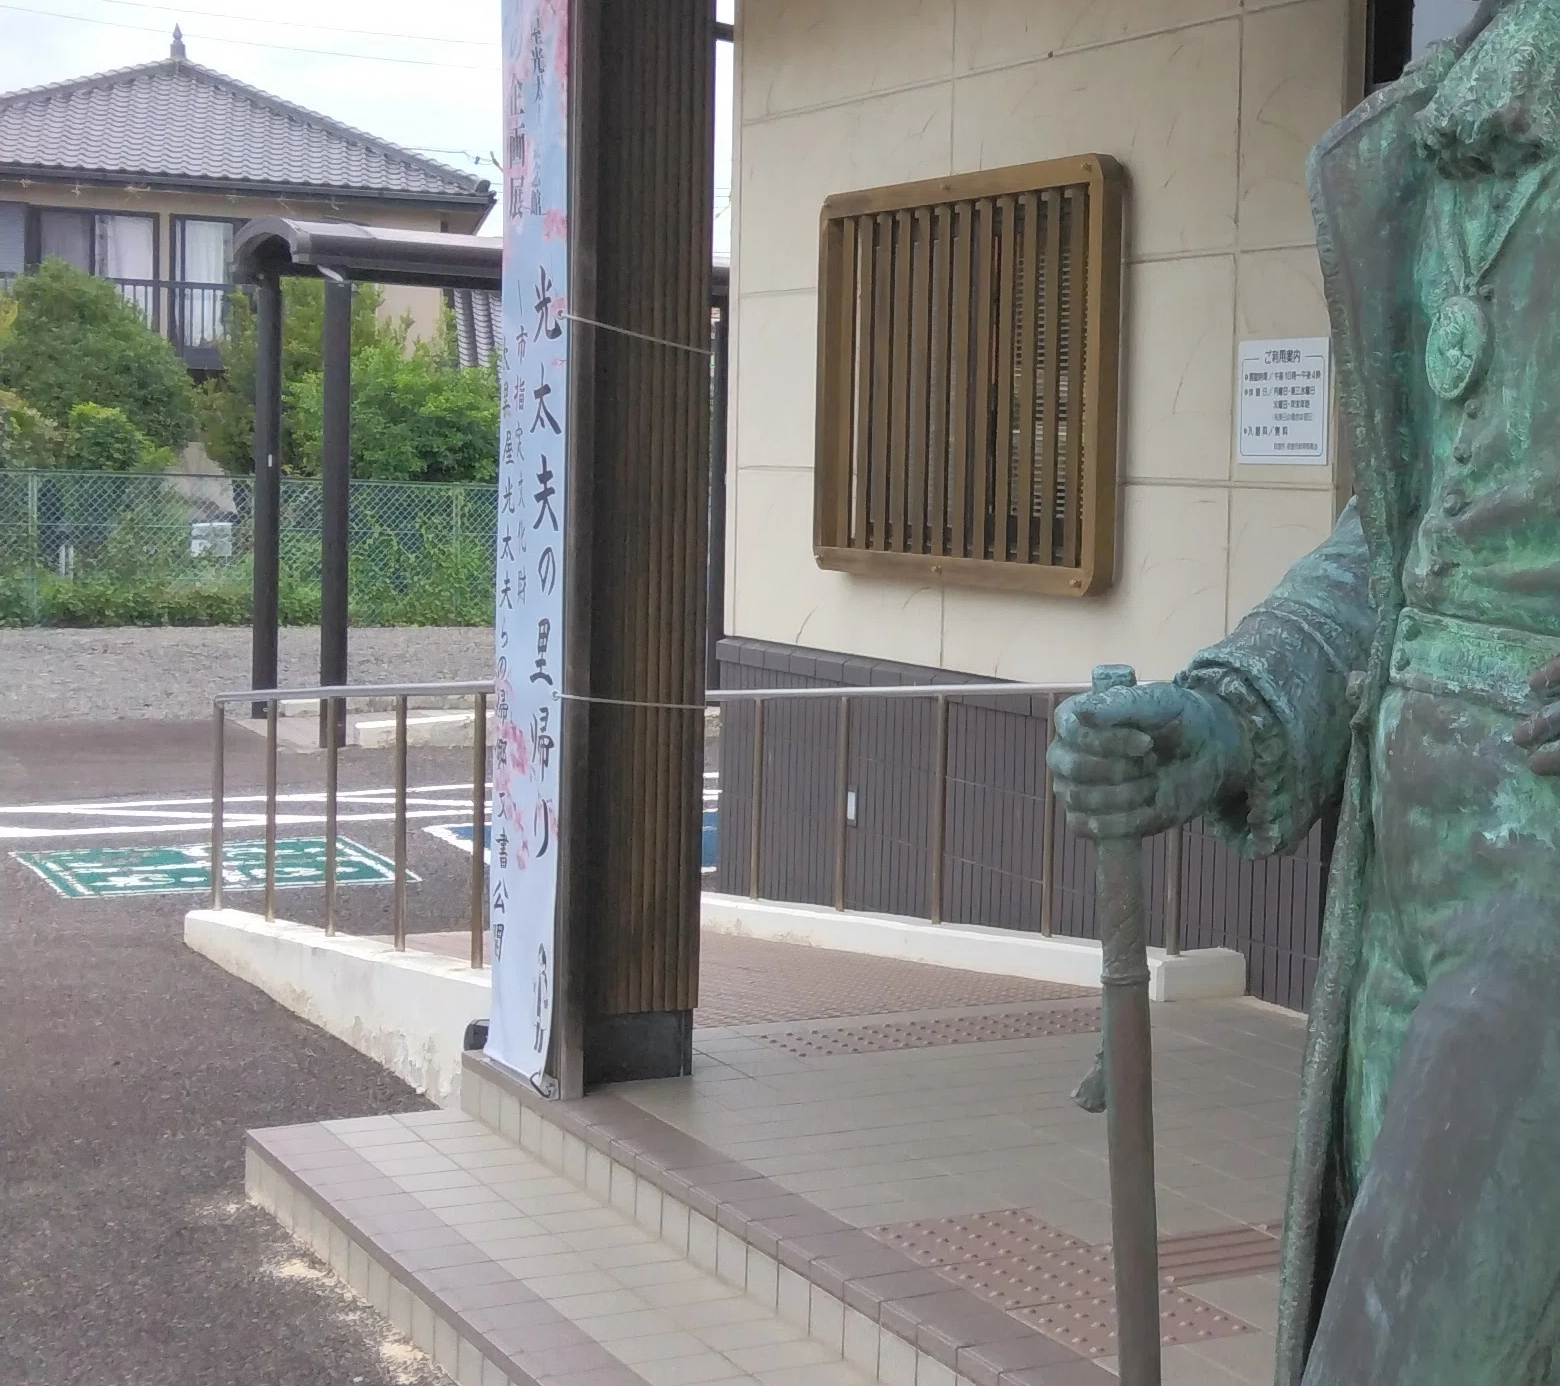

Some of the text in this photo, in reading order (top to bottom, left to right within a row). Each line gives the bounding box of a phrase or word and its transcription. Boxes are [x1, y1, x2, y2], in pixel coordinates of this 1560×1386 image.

[1264, 349, 1301, 364] ご利用案内
[530, 264, 563, 859] 光太夫の里帰り
